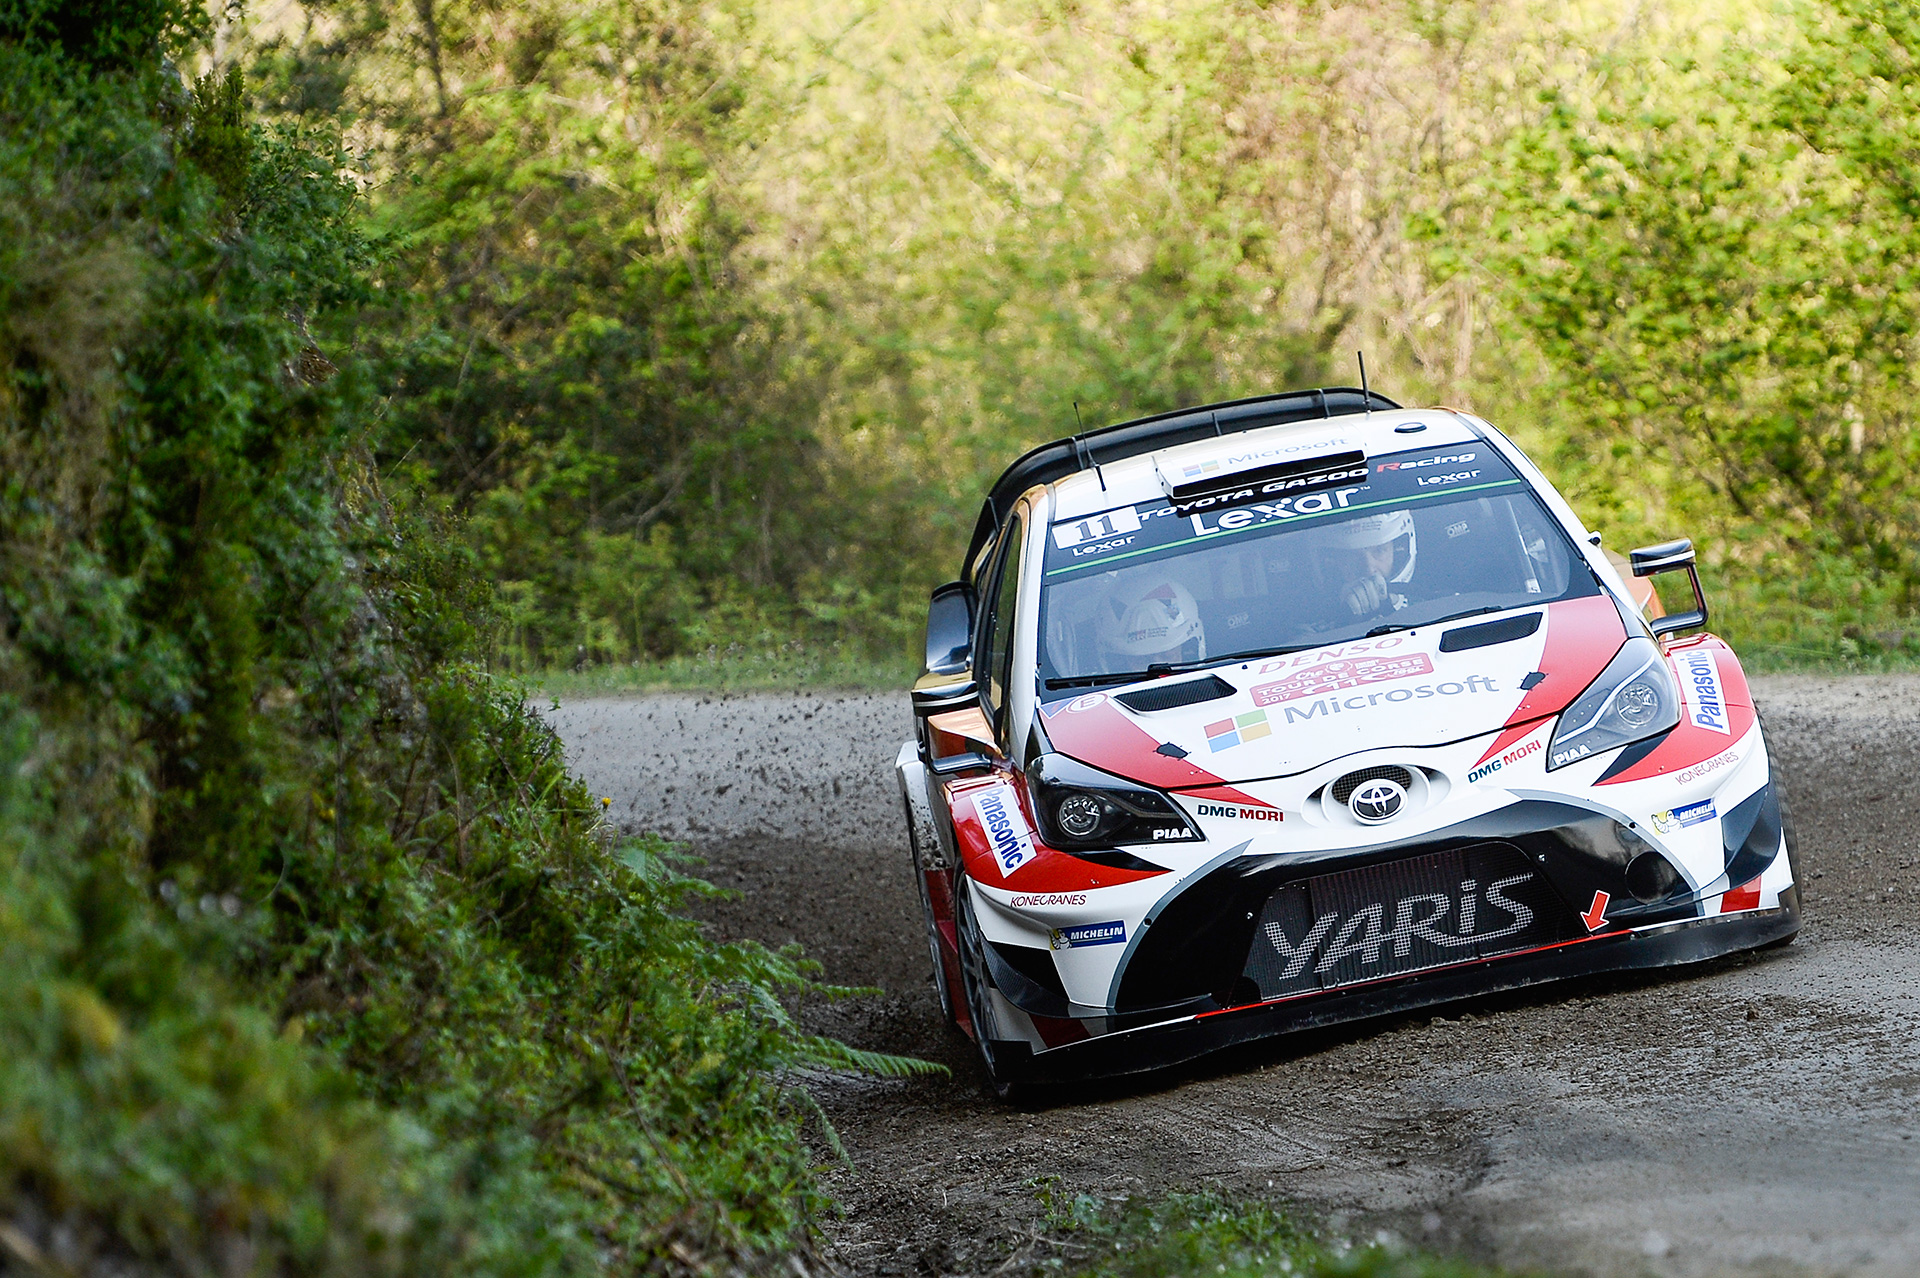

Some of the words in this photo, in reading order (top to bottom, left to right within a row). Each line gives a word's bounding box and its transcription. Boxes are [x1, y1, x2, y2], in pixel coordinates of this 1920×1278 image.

[1228, 437, 1348, 465] Microsoft
[1136, 488, 1254, 521] TOYOTA
[1261, 467, 1370, 494] GAZOO
[1376, 452, 1476, 473] Racing
[1416, 469, 1481, 487] Lexar
[1075, 514, 1119, 542] 11
[1447, 523, 1468, 537] OMP
[1072, 535, 1136, 557] Lexar
[1227, 613, 1249, 627] OMP
[1258, 637, 1404, 675] DENSO
[1257, 680, 1316, 697] TOUR
[1322, 671, 1350, 683] DE
[1356, 658, 1425, 676] CORSE
[1261, 692, 1292, 705] 2017
[1283, 674, 1500, 724] Microsoft
[1679, 650, 1724, 730] Panasonic
[1081, 696, 1096, 708] E
[1467, 759, 1502, 784] DMG
[1503, 739, 1542, 766] MORI
[1552, 744, 1592, 766] PIAA
[1675, 751, 1740, 786] KONECRANES
[1197, 804, 1237, 818] DMG
[1239, 808, 1284, 822] MORI
[976, 786, 1028, 870] Panasonic
[1152, 827, 1193, 840] PIAA
[1010, 894, 1087, 908] KONECRANES
[1070, 926, 1124, 940] MICHELIN
